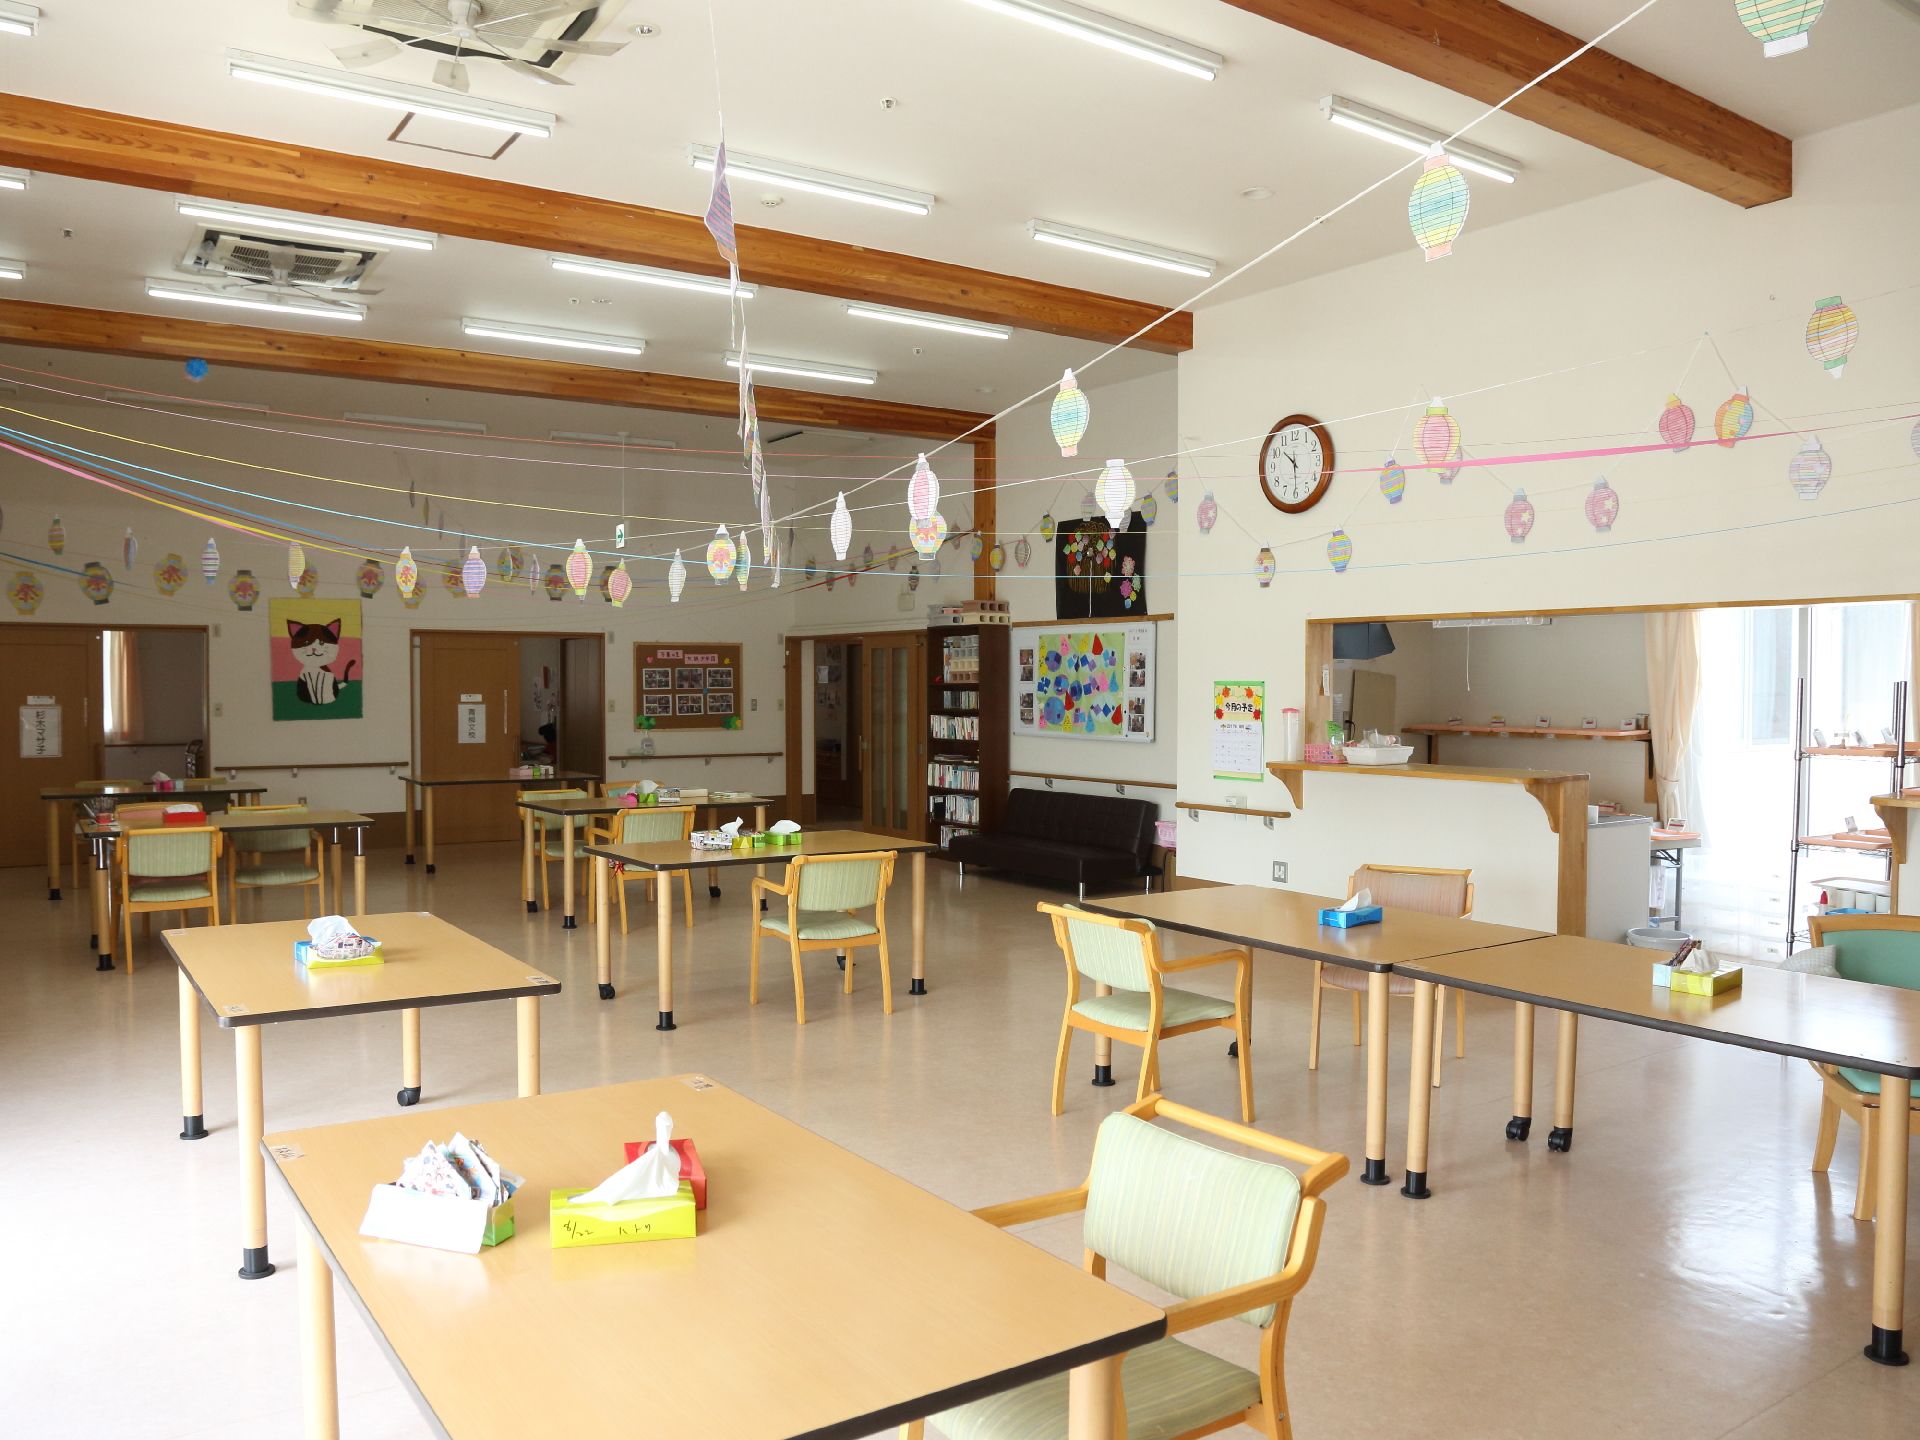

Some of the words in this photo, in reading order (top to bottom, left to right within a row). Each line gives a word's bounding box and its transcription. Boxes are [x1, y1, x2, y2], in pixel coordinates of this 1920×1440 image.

[1281, 435, 1287, 446] 11
[1291, 430, 1299, 441] 12
[1311, 440, 1317, 452] 2
[1273, 447, 1280, 459] 10
[1316, 455, 1320, 467] 3
[1270, 462, 1275, 473] 9
[1274, 476, 1280, 487] 8
[1312, 471, 1317, 481] 4
[1283, 485, 1288, 496] 7
[1293, 487, 1299, 499] 6
[1304, 482, 1310, 493] 5
[1225, 702, 1254, 713] 今月の予定
